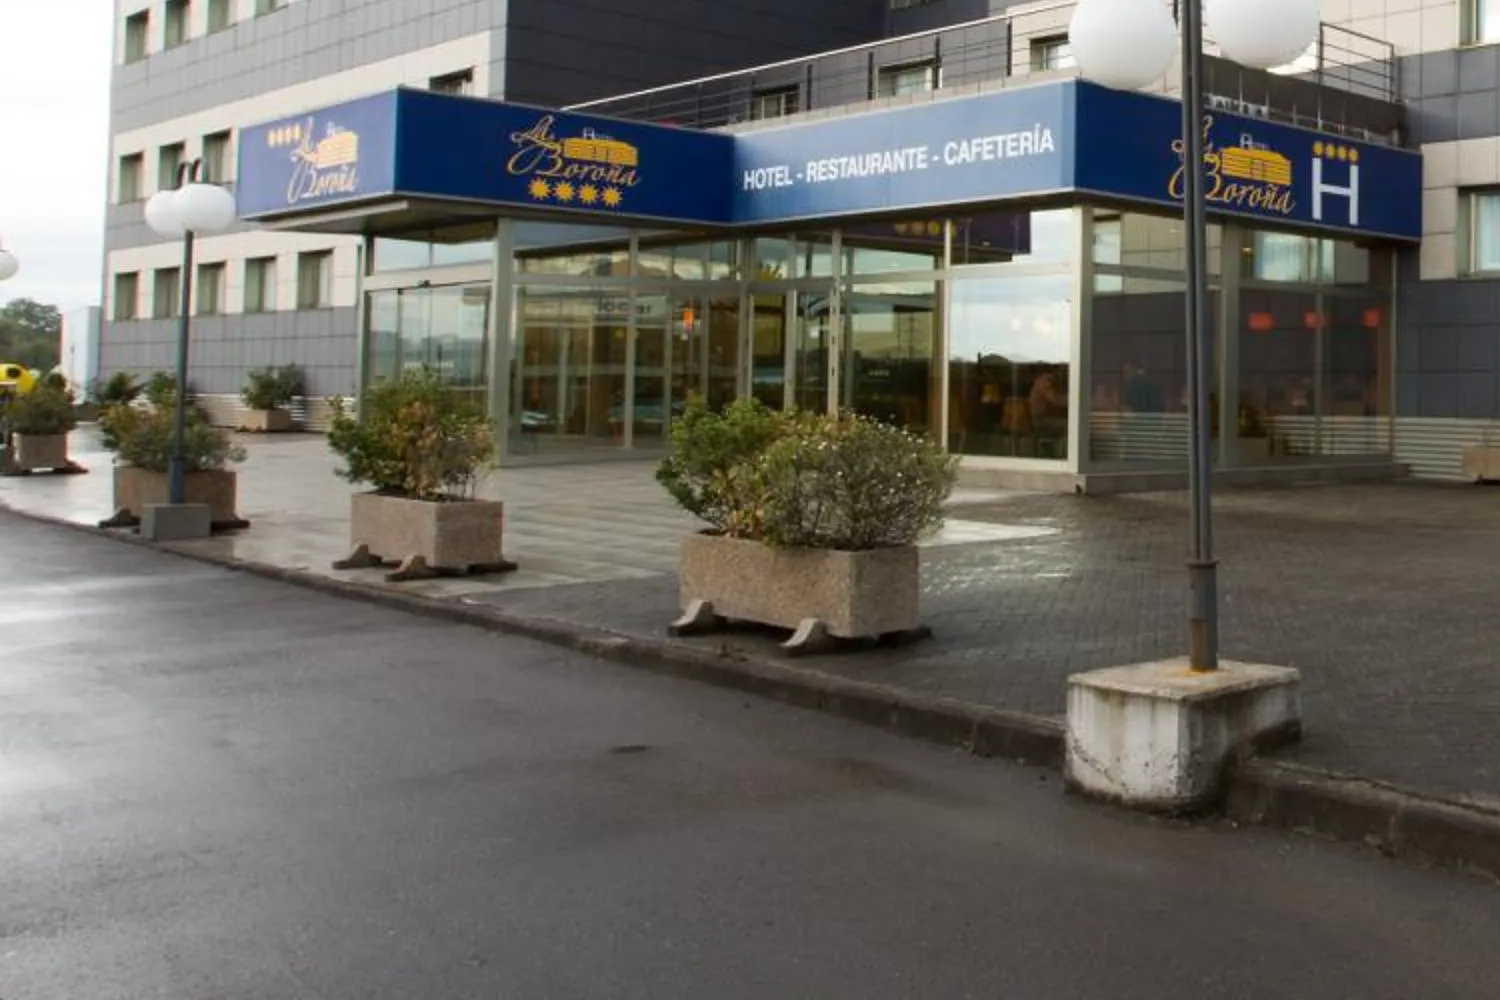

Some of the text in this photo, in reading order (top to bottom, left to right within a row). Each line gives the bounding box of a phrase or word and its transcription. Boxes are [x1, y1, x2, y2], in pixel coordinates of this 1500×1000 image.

[507, 145, 642, 187] Boroña
[743, 165, 794, 191] HOTEL
[806, 146, 929, 184] RESTAURANTE
[943, 123, 1055, 166] CAFETERÍA
[1312, 156, 1360, 226] H
